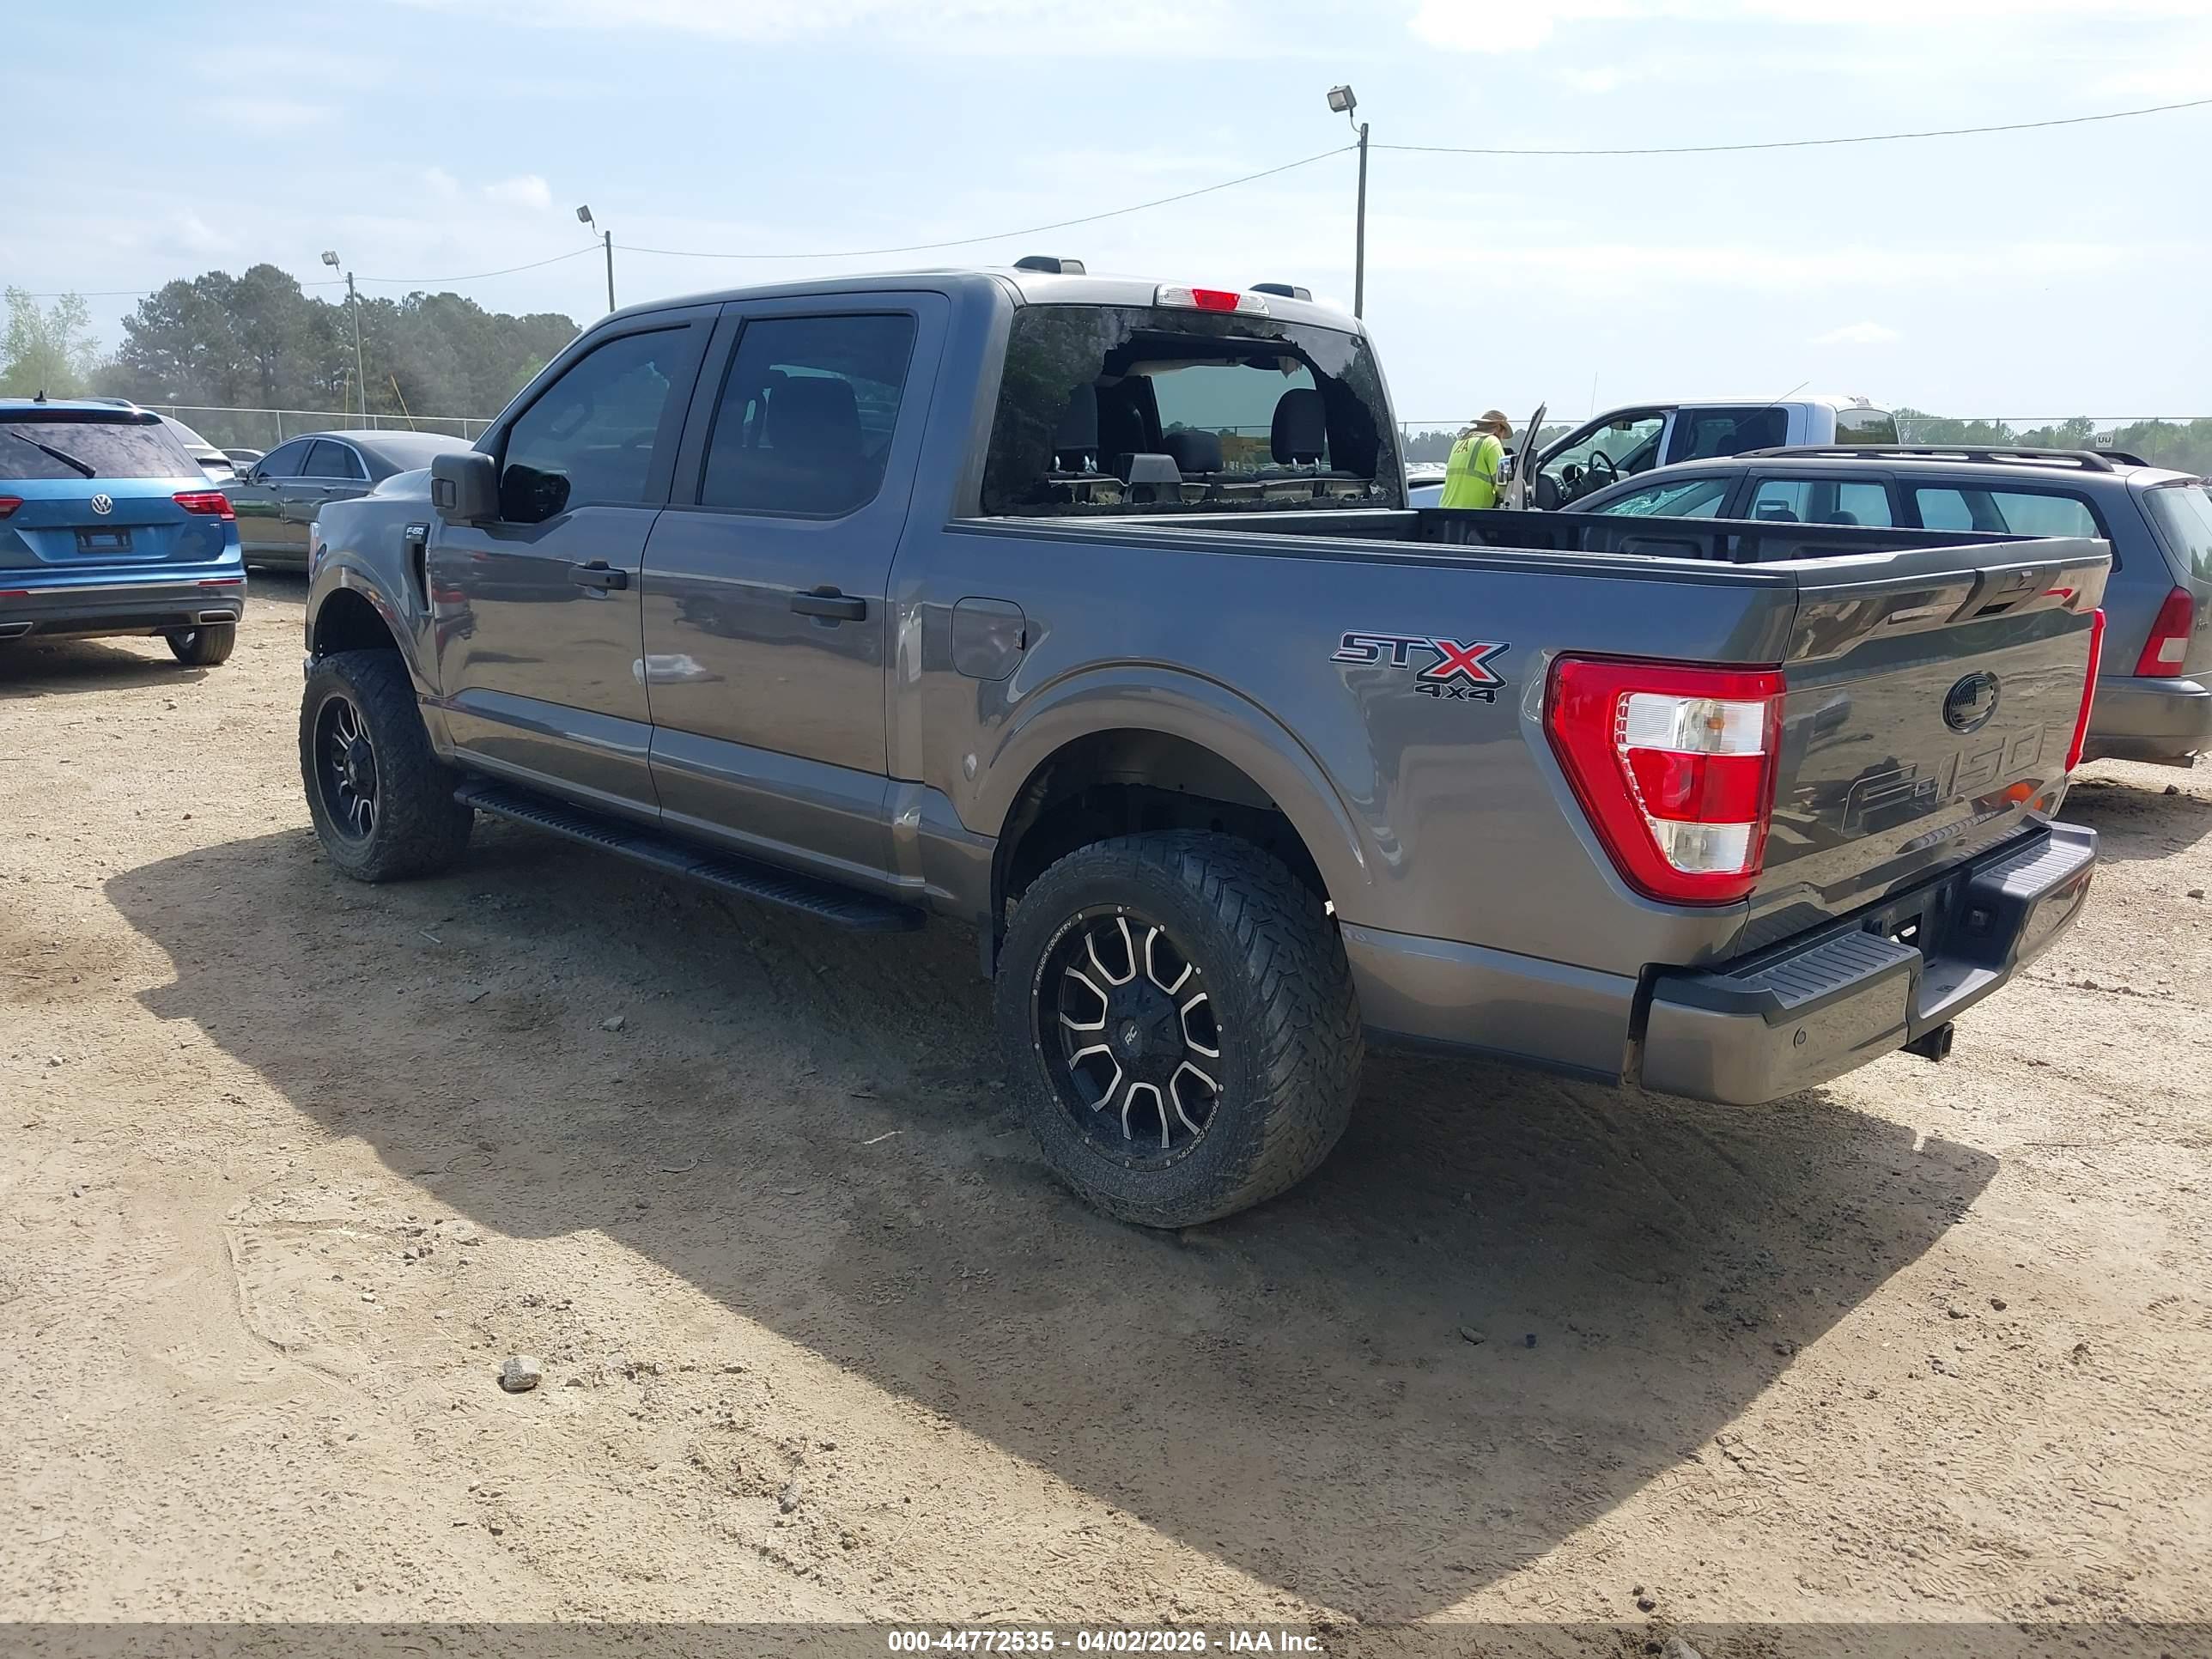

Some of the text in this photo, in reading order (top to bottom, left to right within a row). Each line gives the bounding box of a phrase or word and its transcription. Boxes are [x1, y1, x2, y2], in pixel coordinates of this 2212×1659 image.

[1328, 629, 1511, 690] STX
[1840, 722, 2047, 835] F-150
[1035, 920, 1072, 981] ROUGH COUNTRY
[1124, 1024, 1138, 1046] RC
[1176, 1098, 1220, 1160] ROUGH COUNTRY
